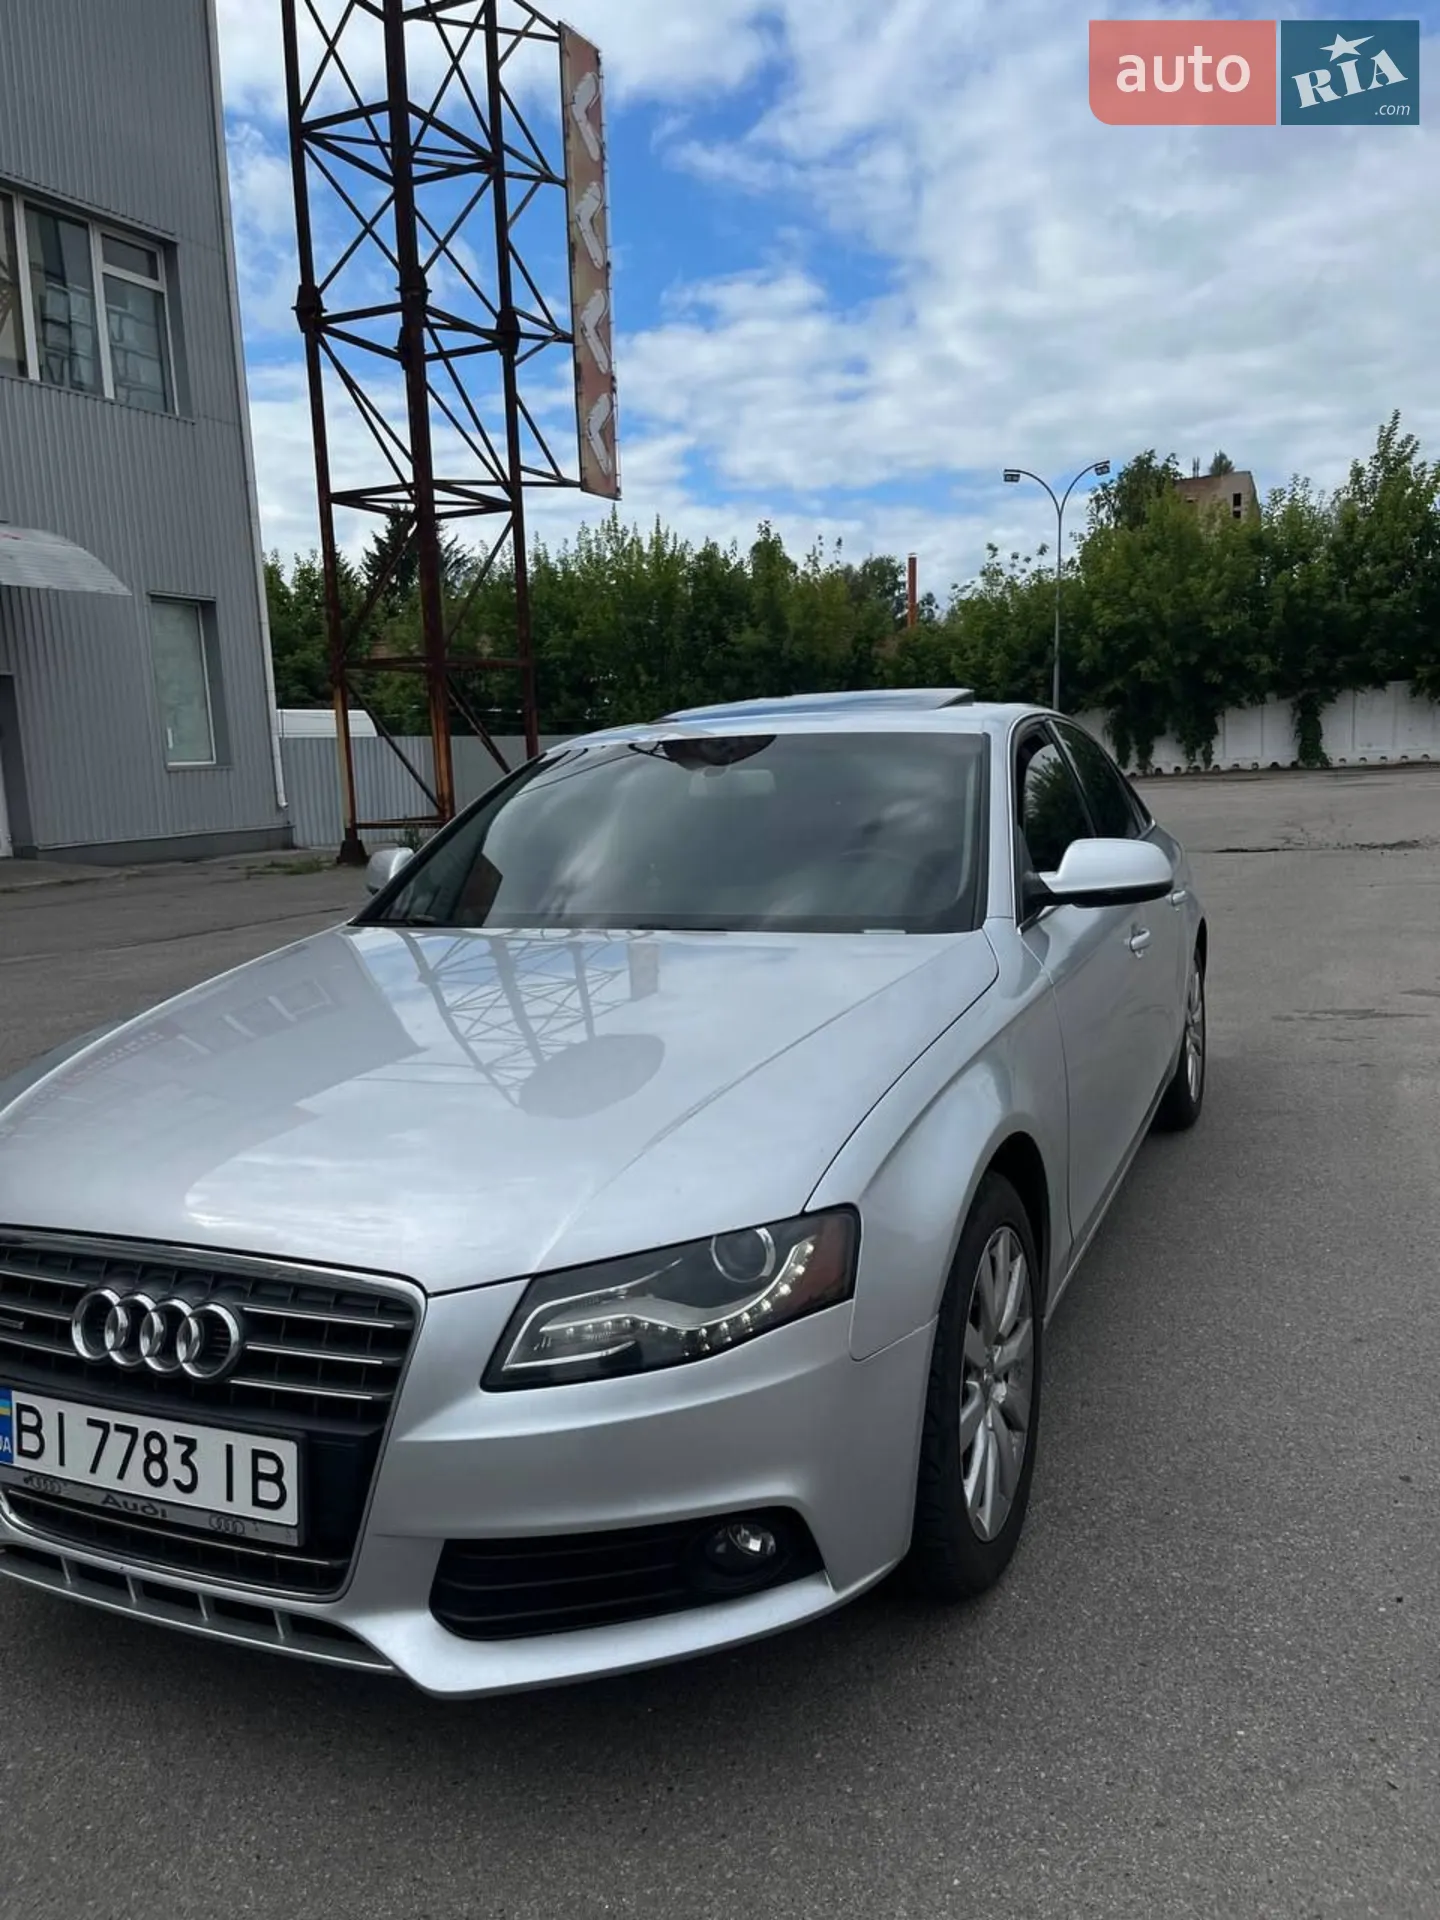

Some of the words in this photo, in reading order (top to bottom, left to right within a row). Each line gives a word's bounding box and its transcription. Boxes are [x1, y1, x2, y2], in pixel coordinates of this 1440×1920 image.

[16, 1402, 65, 1467] BI
[86, 1417, 199, 1494] 7783
[225, 1444, 288, 1511] IB
[102, 1494, 168, 1518] Audi
